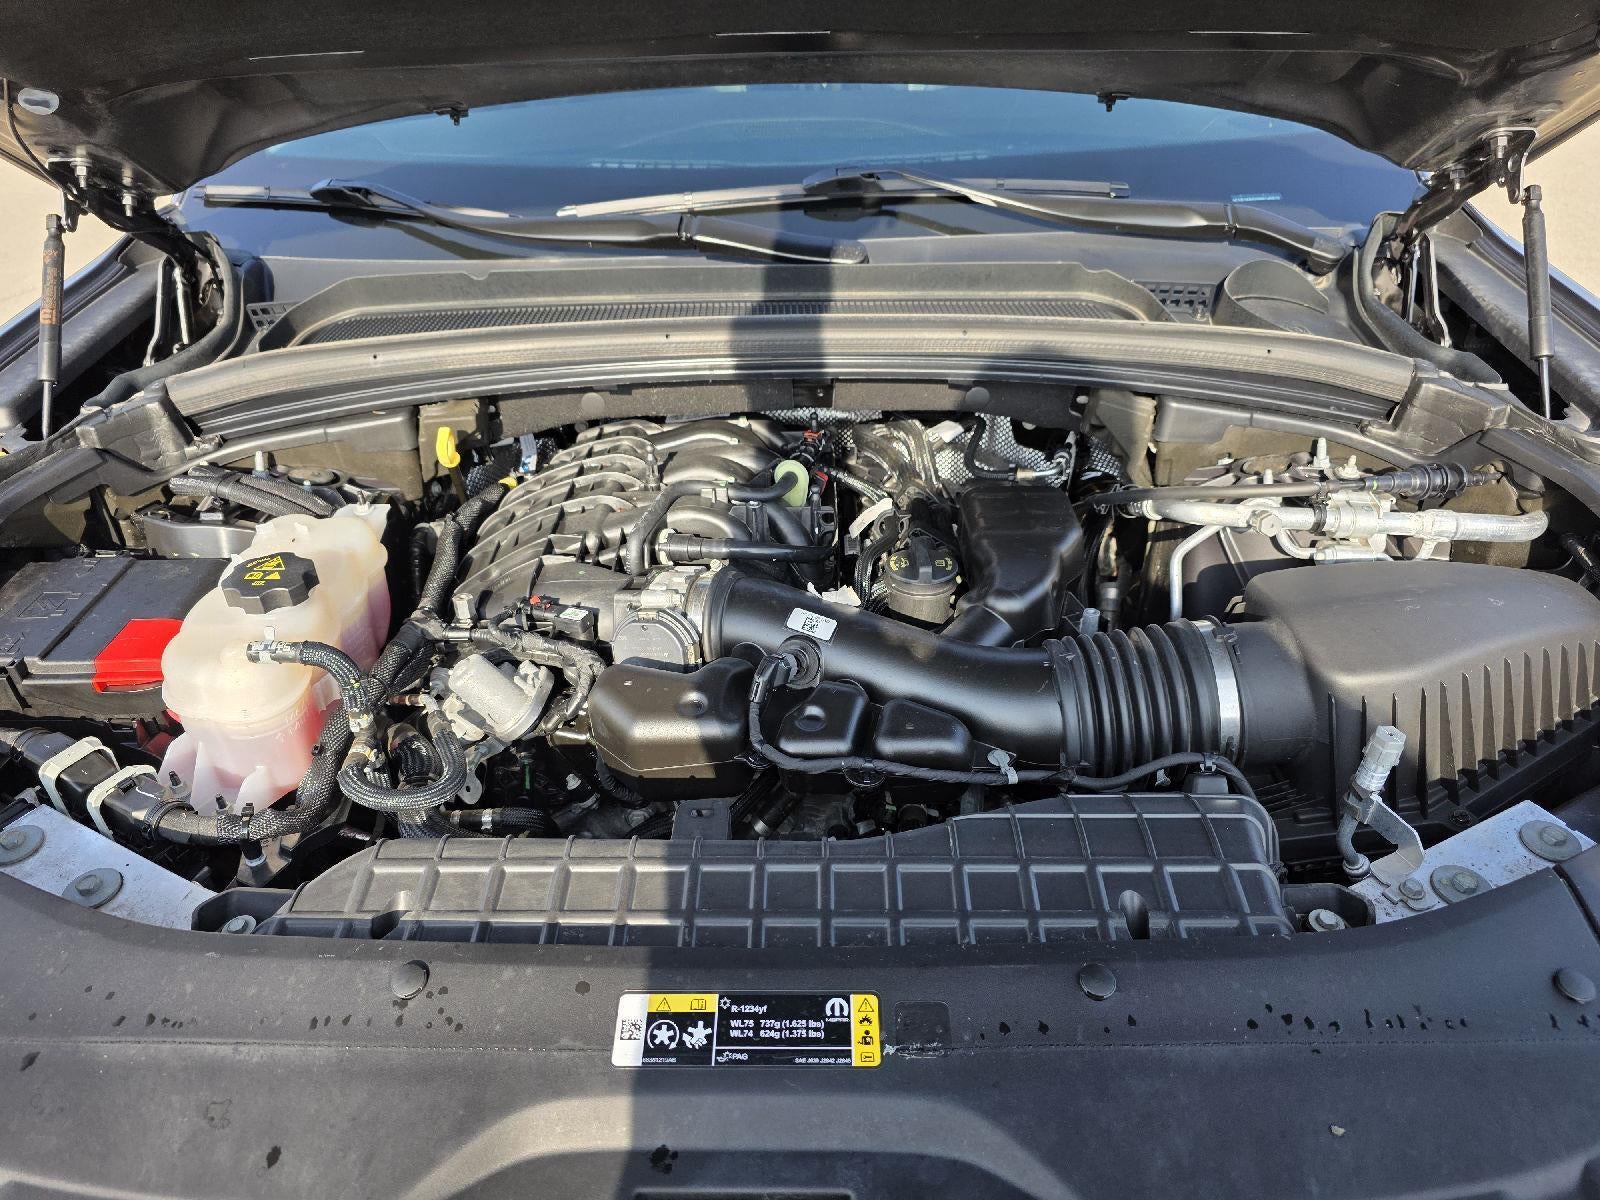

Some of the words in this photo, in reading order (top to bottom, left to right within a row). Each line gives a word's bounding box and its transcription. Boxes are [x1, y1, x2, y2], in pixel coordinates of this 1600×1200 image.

[731, 1005, 767, 1014] R-1234yf
[730, 1020, 754, 1028] WL75
[760, 1020, 780, 1029] 737g
[782, 1020, 807, 1029] (1.625
[809, 1020, 824, 1029] lbs)
[730, 1030, 753, 1038] WL74
[760, 1030, 780, 1039] 624g
[782, 1030, 807, 1039] (1.375
[809, 1030, 824, 1039] lbs)
